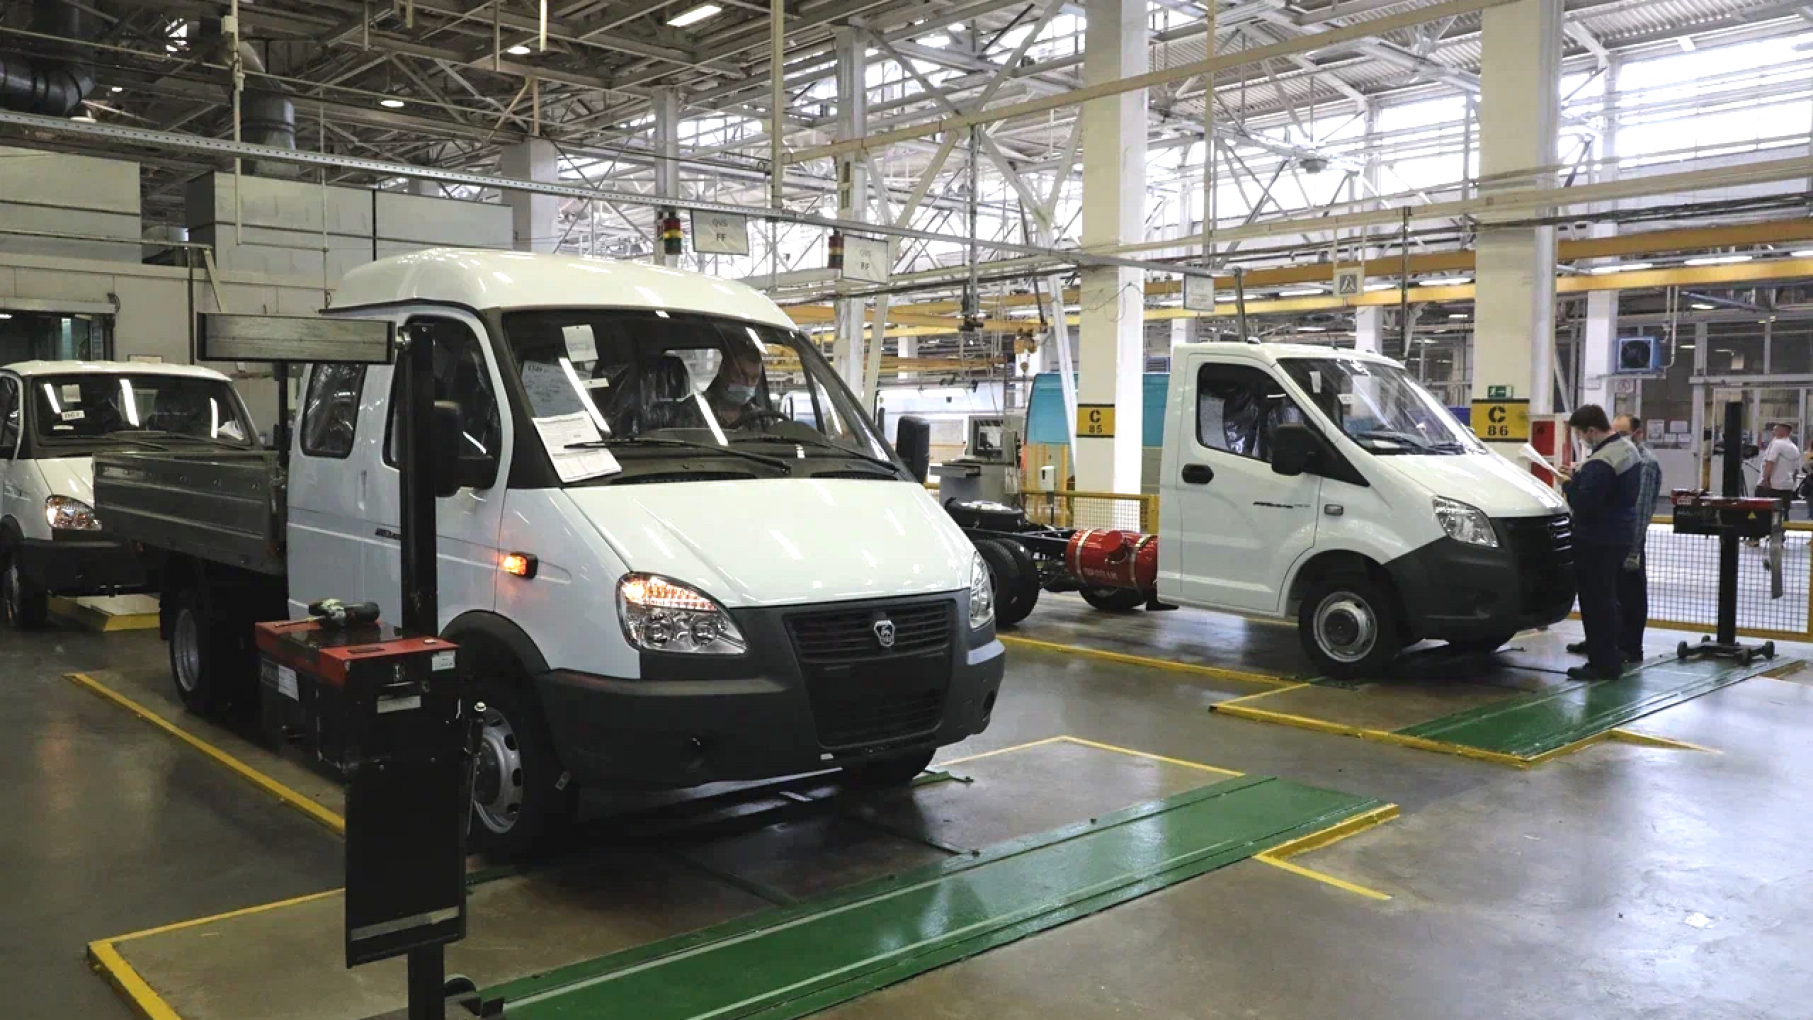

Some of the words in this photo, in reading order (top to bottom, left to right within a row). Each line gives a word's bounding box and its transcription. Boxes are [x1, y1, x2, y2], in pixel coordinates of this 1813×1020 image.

[716, 233, 727, 242] FF
[1089, 409, 1101, 423] C
[1488, 405, 1507, 423] C
[1088, 424, 1103, 433] 85
[1488, 425, 1509, 436] 86
